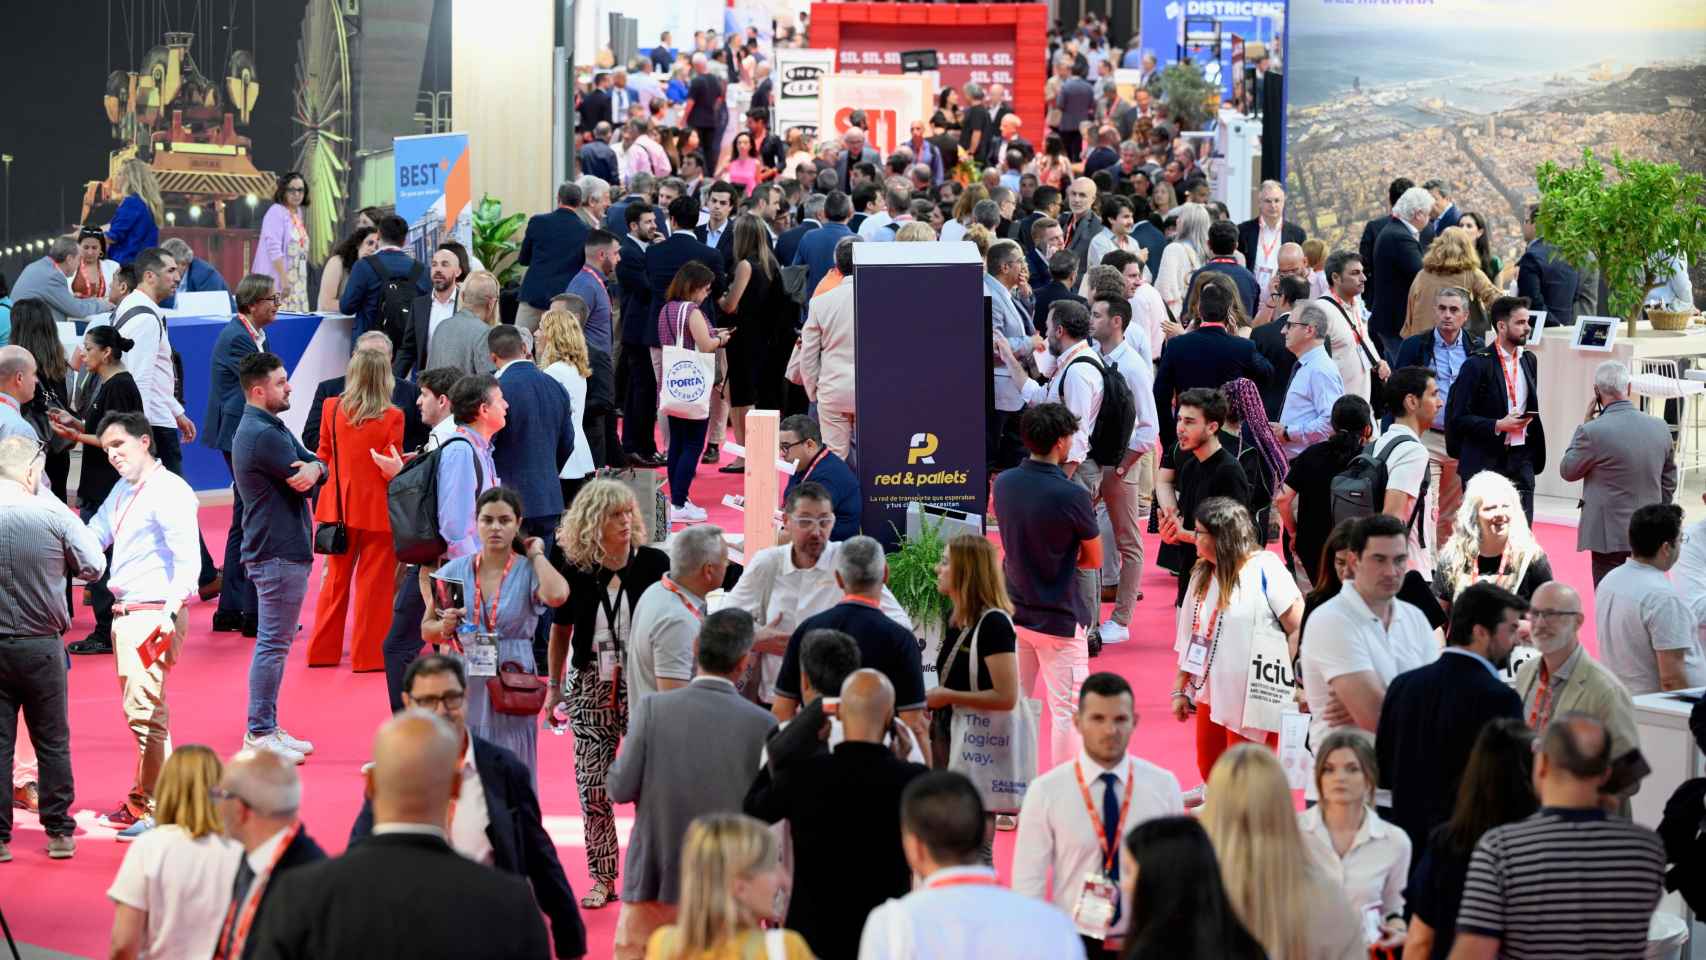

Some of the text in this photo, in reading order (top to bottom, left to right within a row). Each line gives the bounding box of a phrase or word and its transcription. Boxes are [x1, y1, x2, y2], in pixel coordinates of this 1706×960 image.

[400, 163, 439, 188] BEST
[670, 377, 702, 388] PORTA
[874, 470, 968, 487] red & pallets
[966, 714, 990, 727] The
[964, 732, 1010, 748] logical
[962, 752, 993, 766] way.
